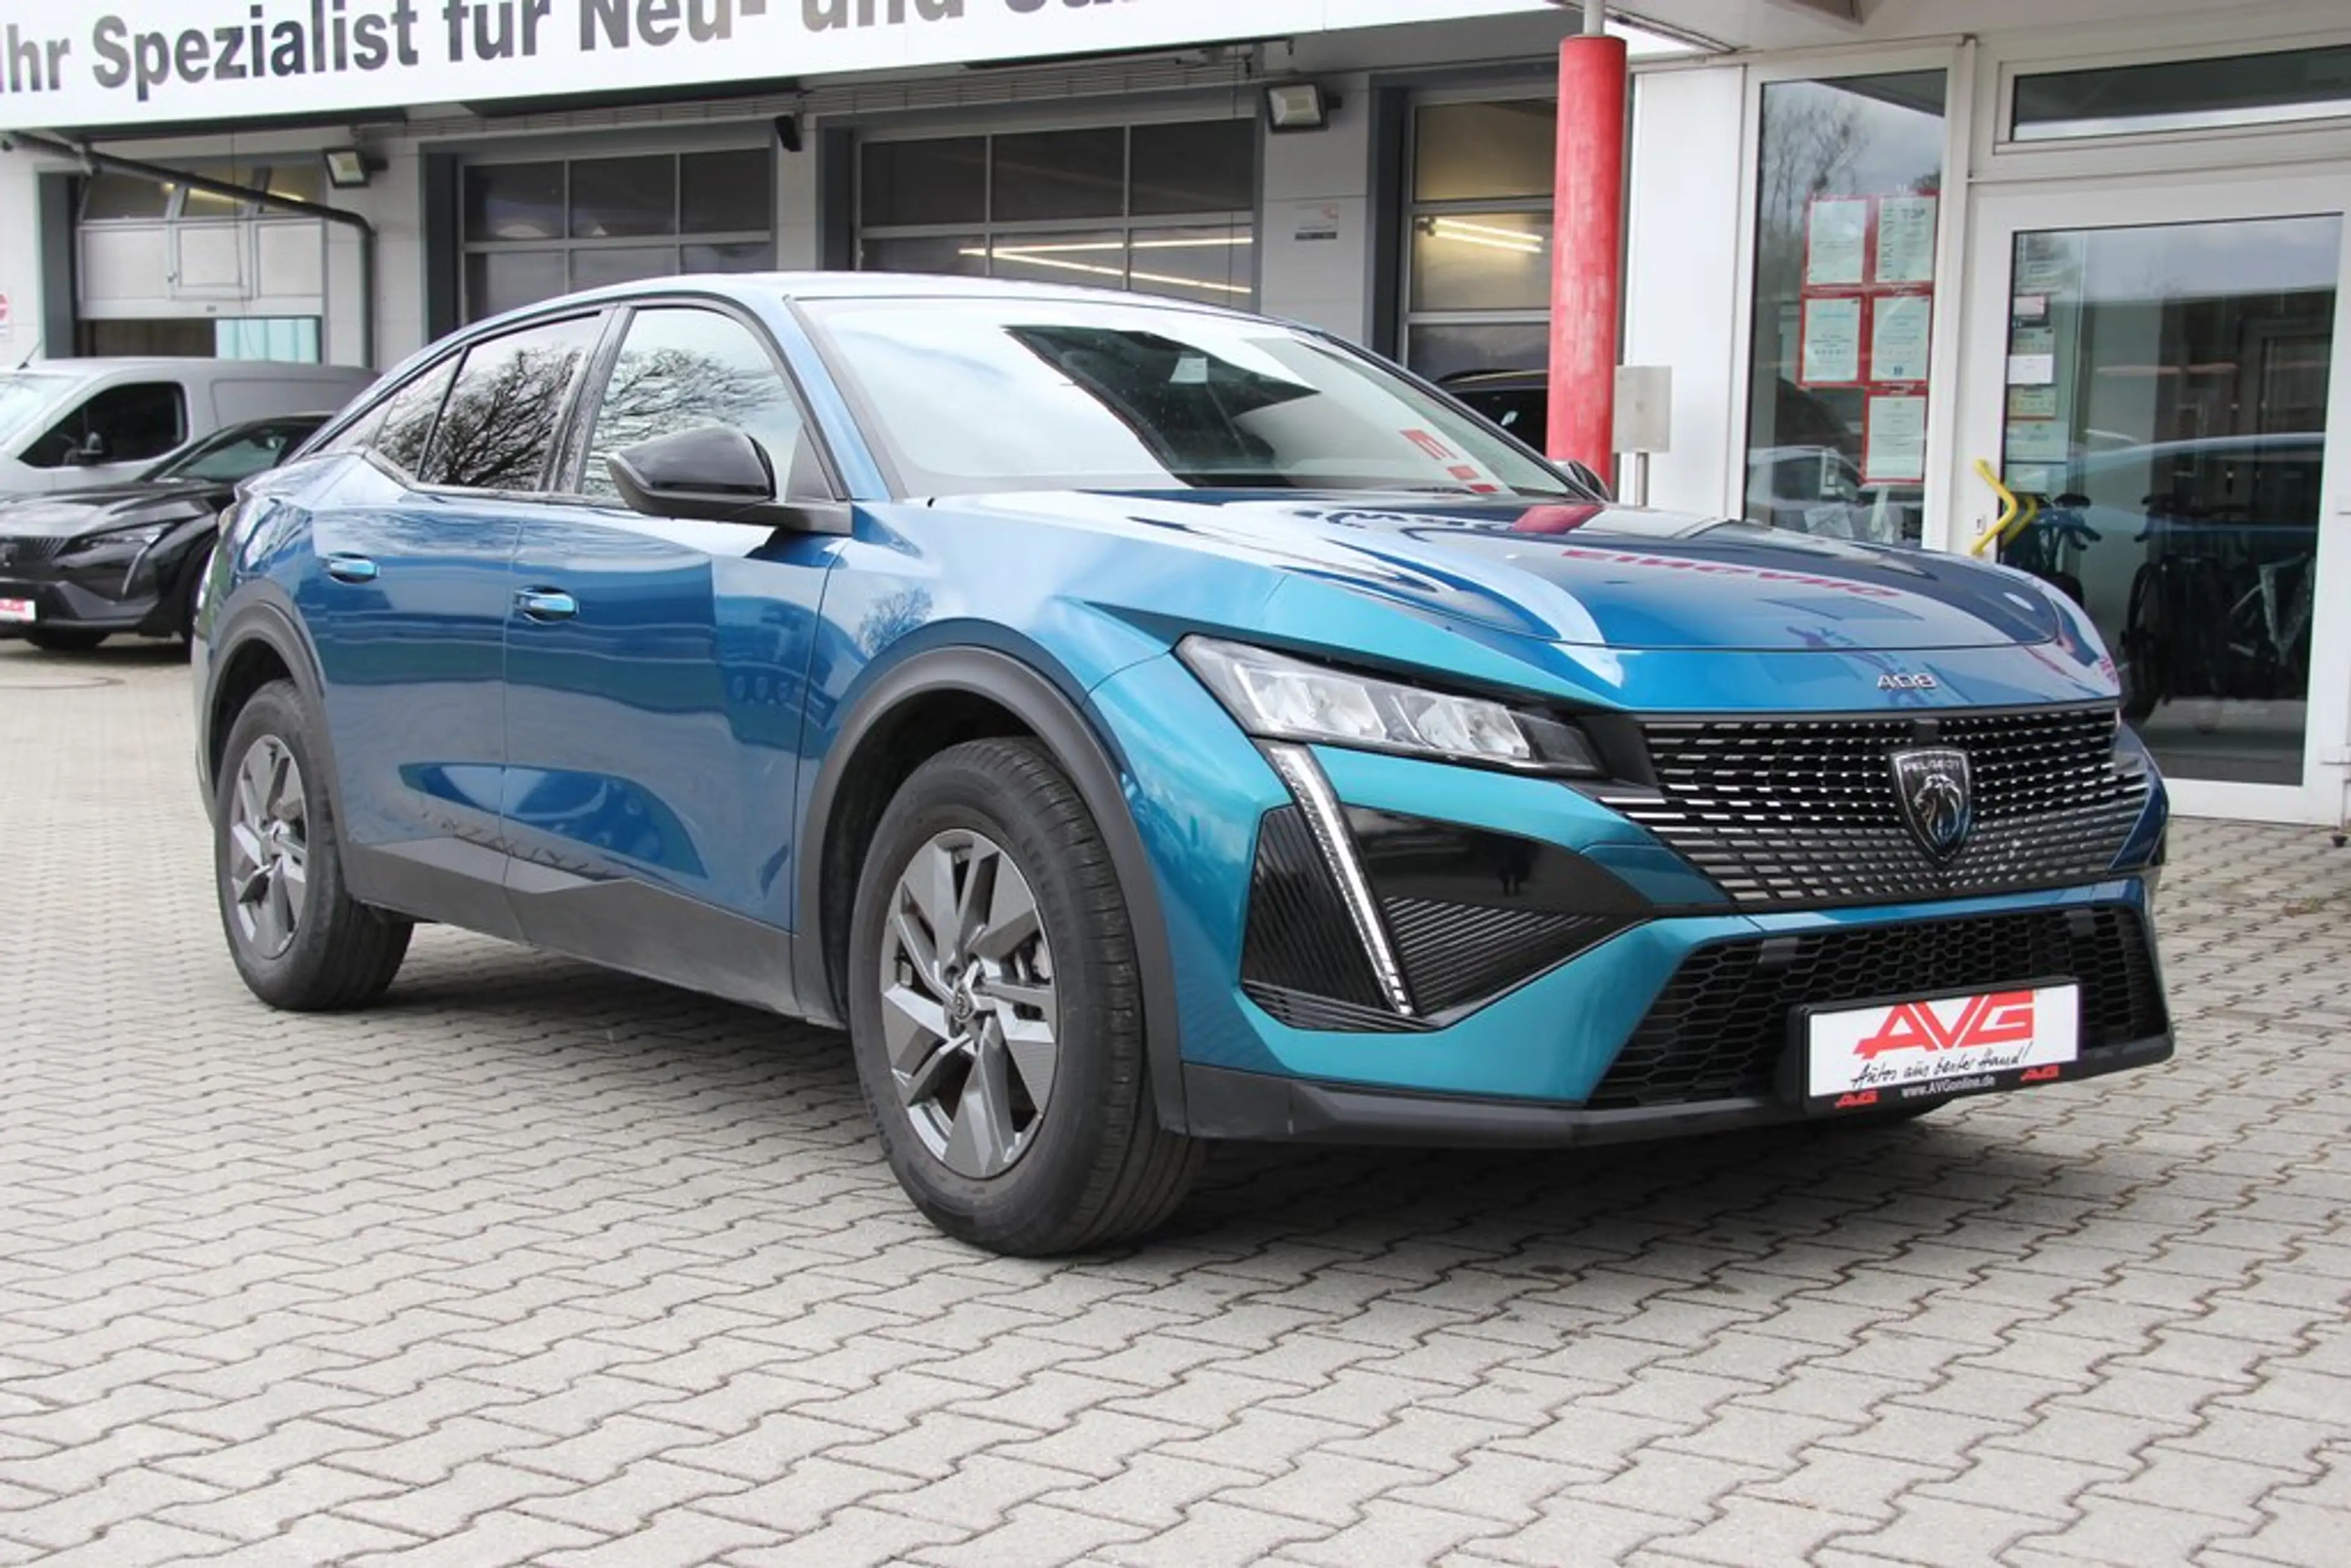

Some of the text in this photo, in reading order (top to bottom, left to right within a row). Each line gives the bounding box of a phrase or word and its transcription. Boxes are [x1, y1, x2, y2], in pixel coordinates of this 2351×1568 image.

[92, 0, 418, 102] Spezialist
[579, 0, 767, 51] Neu-
[1877, 673, 1937, 689] 408
[1853, 989, 2034, 1060] AVG
[1900, 1074, 1996, 1098] www.AVGonline.de
[1835, 1089, 1879, 1109] AVG
